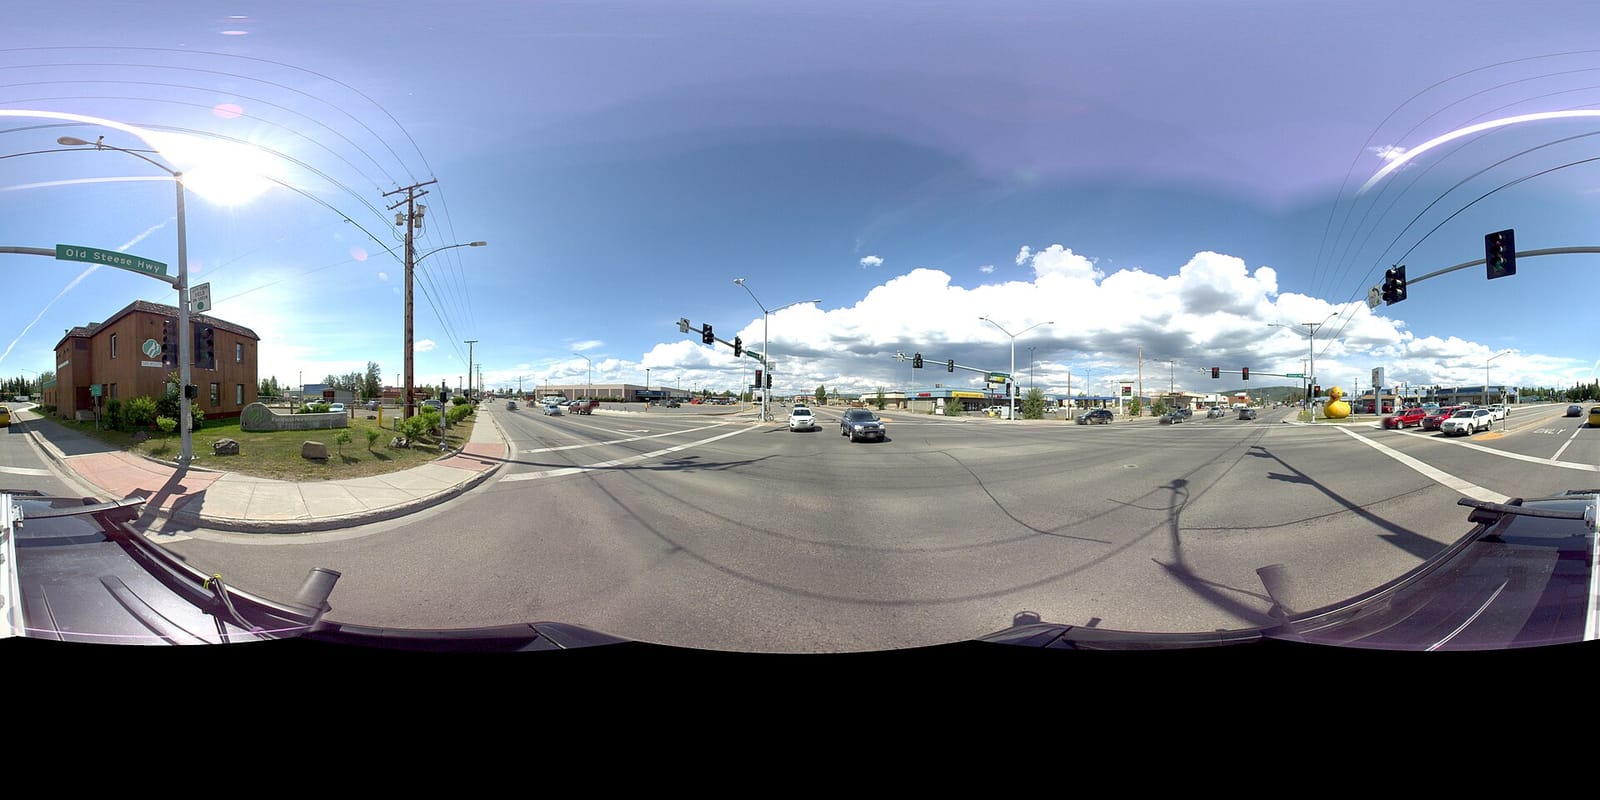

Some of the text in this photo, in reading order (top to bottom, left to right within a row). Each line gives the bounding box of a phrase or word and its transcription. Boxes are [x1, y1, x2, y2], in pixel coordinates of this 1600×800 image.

[65, 248, 160, 273] Old Steese Hwy
